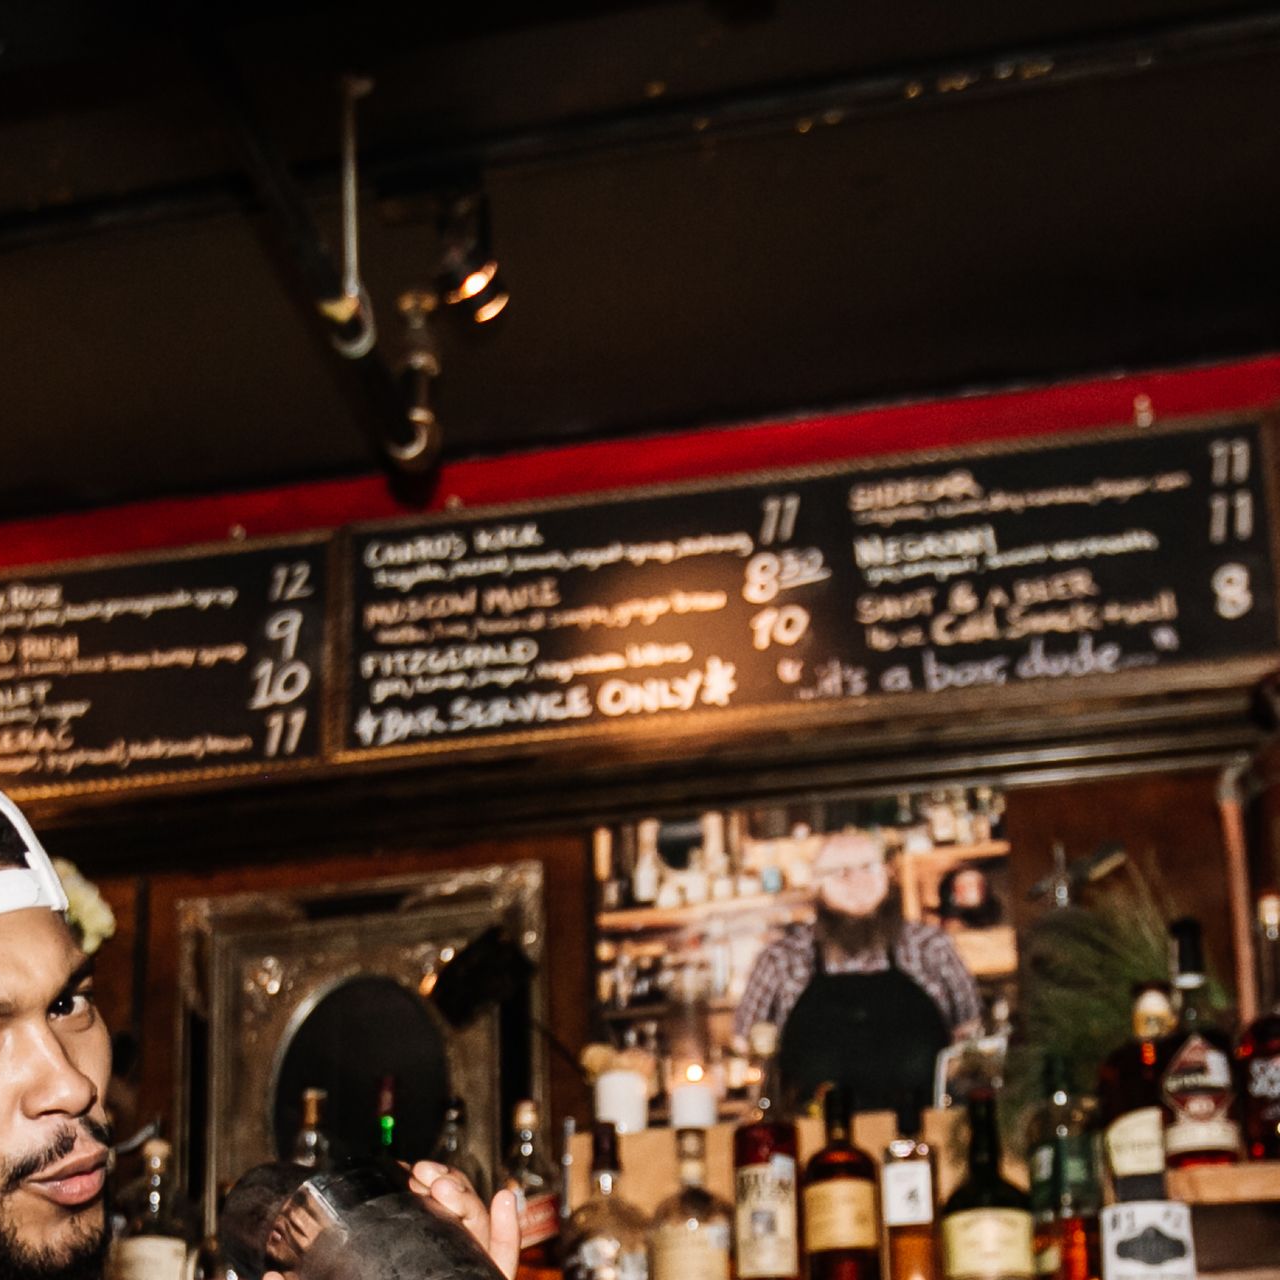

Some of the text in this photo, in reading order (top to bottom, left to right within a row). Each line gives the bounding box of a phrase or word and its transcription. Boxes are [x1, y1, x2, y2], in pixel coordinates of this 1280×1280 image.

[1209, 438, 1250, 486] 11
[760, 493, 800, 544] 11
[1209, 489, 1253, 545] 11
[271, 561, 314, 601] 12
[1212, 562, 1253, 619] 8
[263, 607, 304, 660] 9
[750, 604, 810, 652] 10
[248, 657, 311, 710] 10
[880, 665, 913, 691] a
[263, 708, 307, 757] 11
